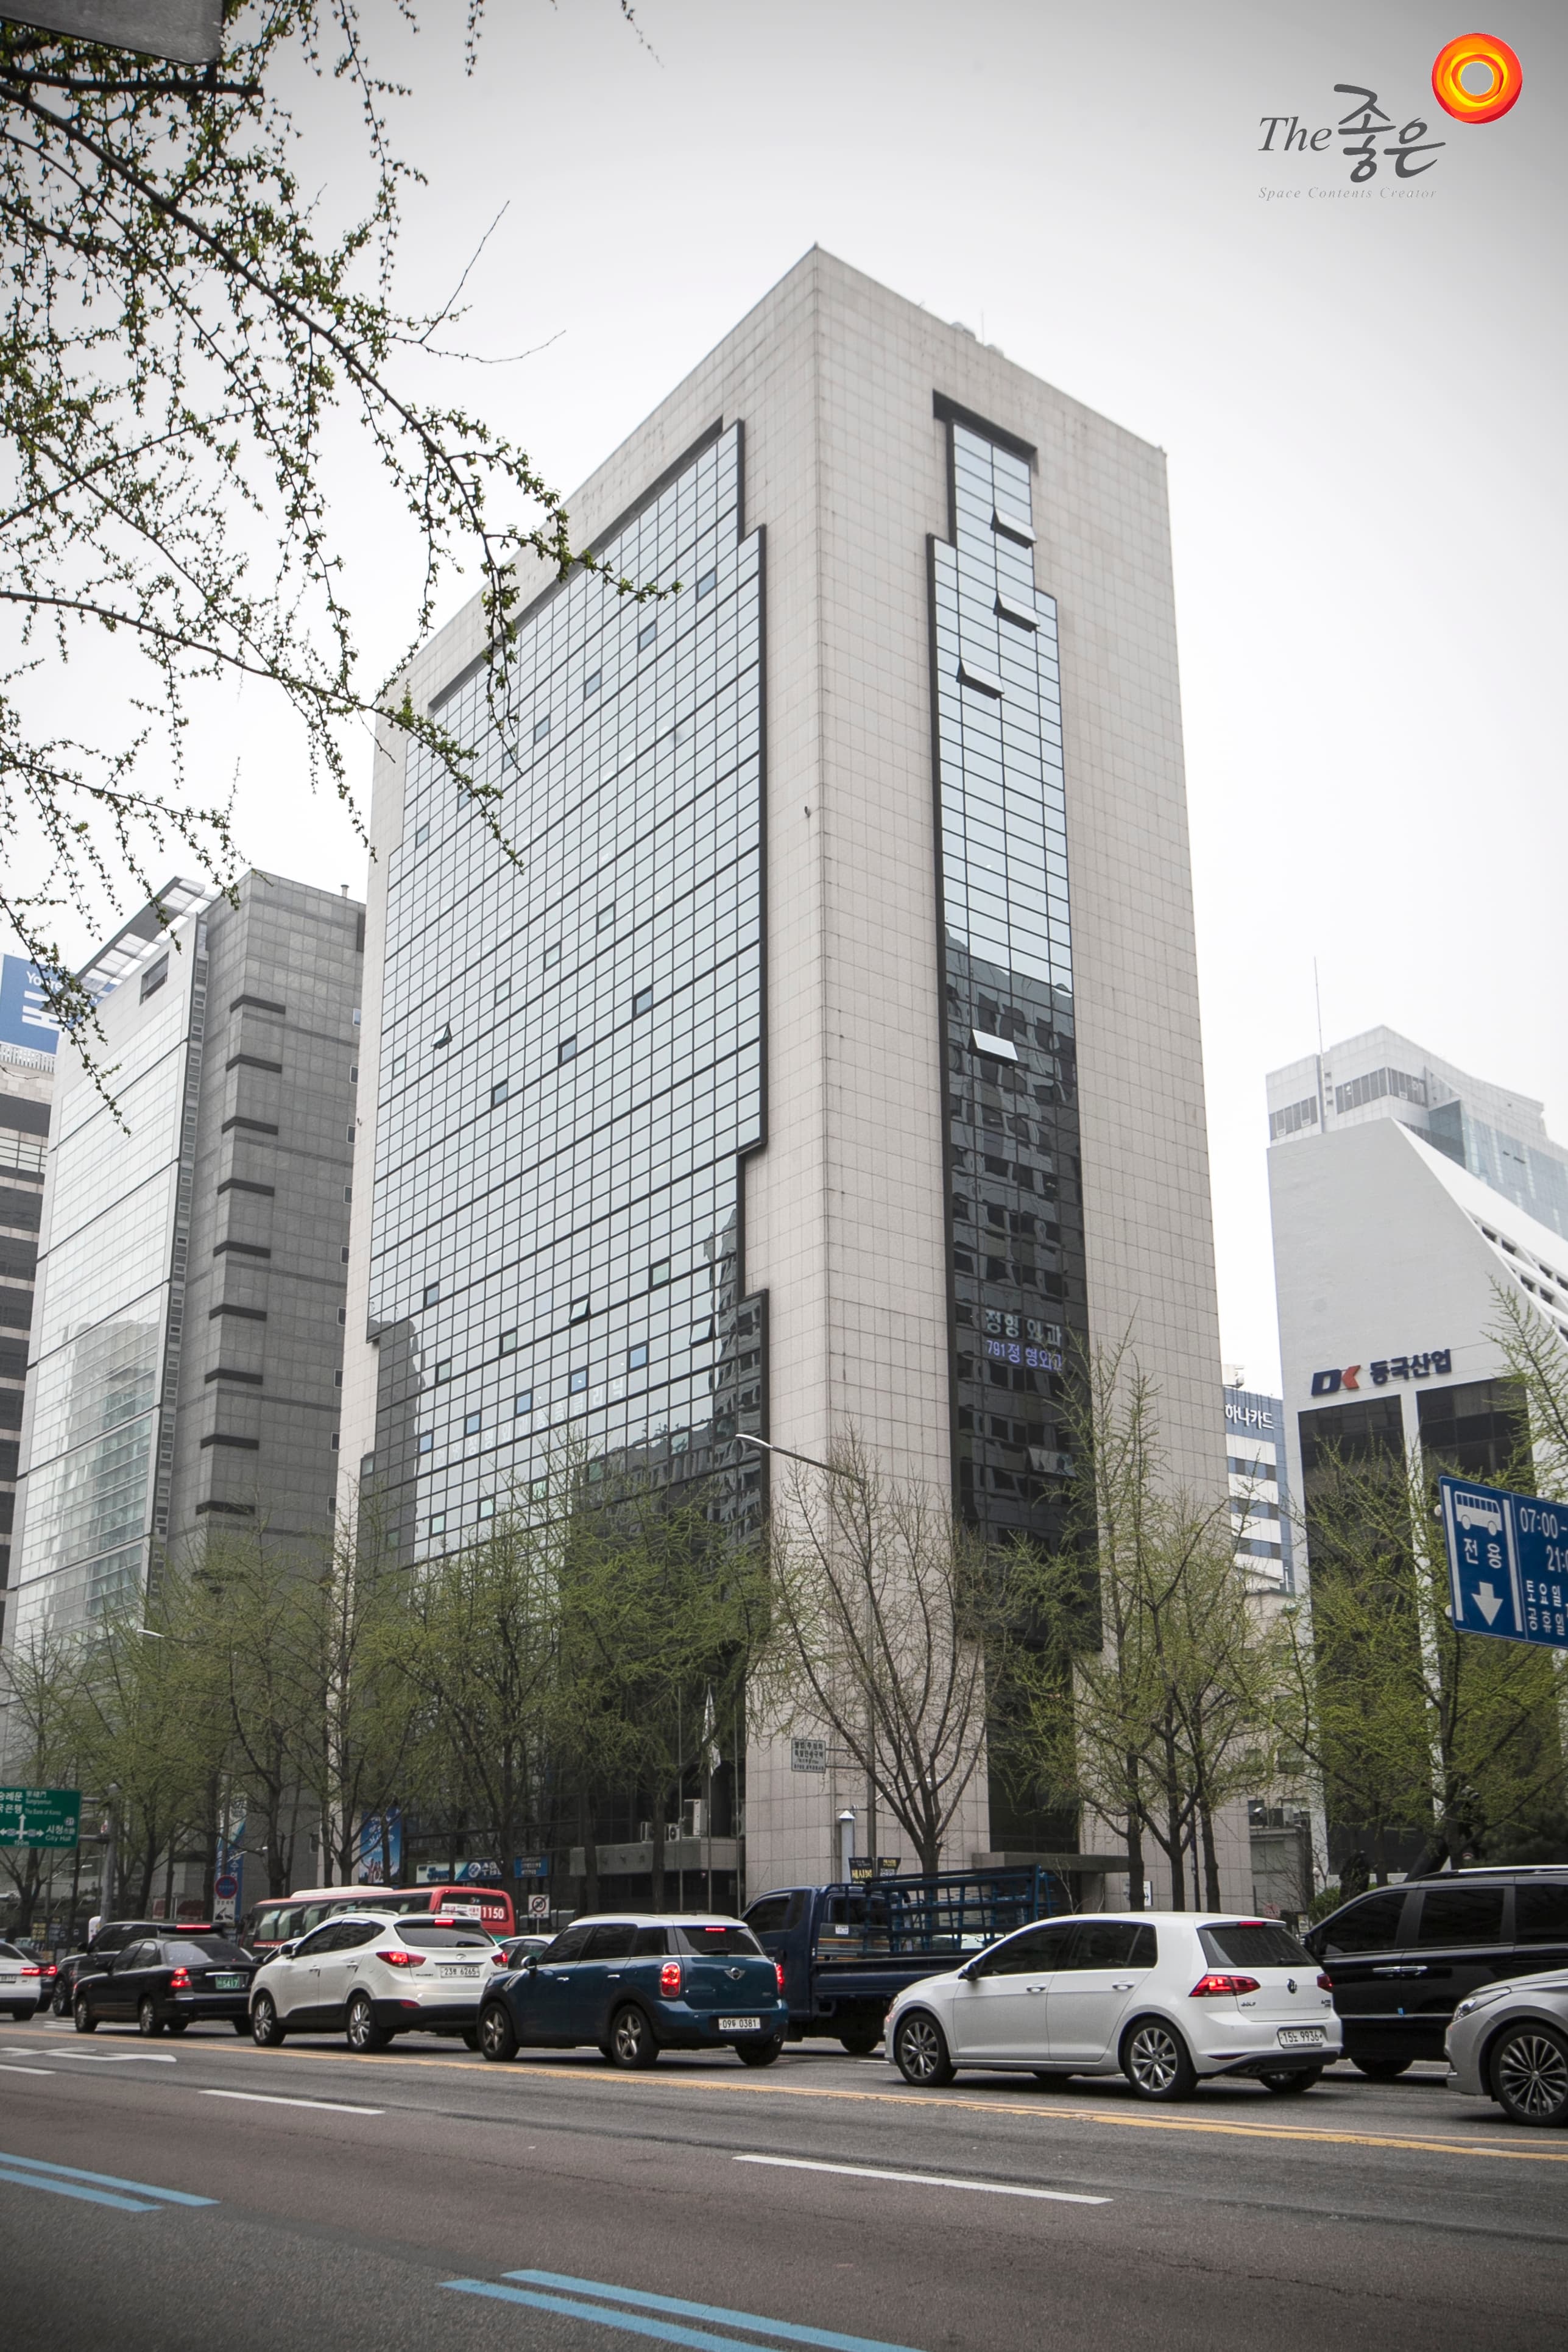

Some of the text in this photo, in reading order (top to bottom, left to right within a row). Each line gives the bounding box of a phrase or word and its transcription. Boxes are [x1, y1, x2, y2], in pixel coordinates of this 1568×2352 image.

[985, 1309, 1061, 1348] 정형외과
[1369, 1348, 1452, 1385] 동국산업
[1224, 1403, 1275, 1430] 하나카드
[1526, 1580, 1562, 1607] 토요일
[1528, 1607, 1566, 1636] 공휴일
[482, 1907, 504, 1919] 1150
[739, 2019, 757, 2028] 0381
